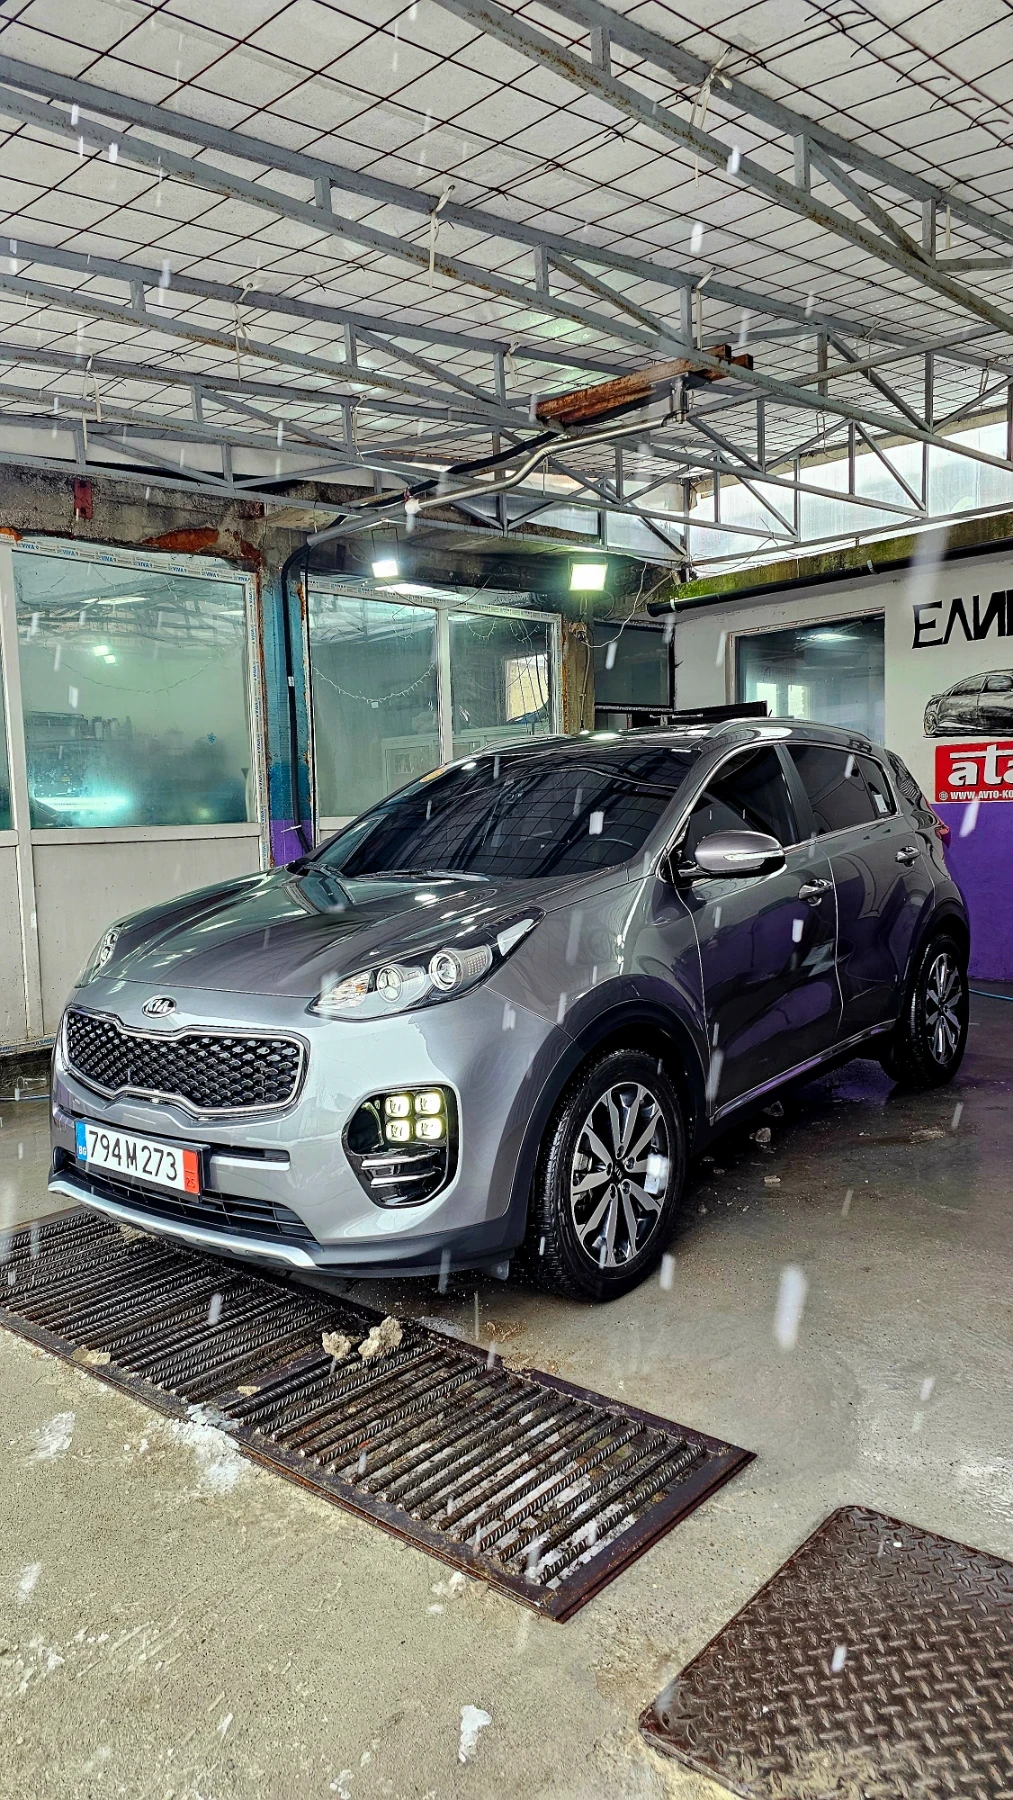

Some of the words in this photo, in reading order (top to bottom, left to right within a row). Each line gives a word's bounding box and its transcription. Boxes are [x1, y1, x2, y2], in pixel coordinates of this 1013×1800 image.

[144, 999, 171, 1013] KIA
[78, 1146, 87, 1155] BG
[186, 1177, 196, 1189] 25
